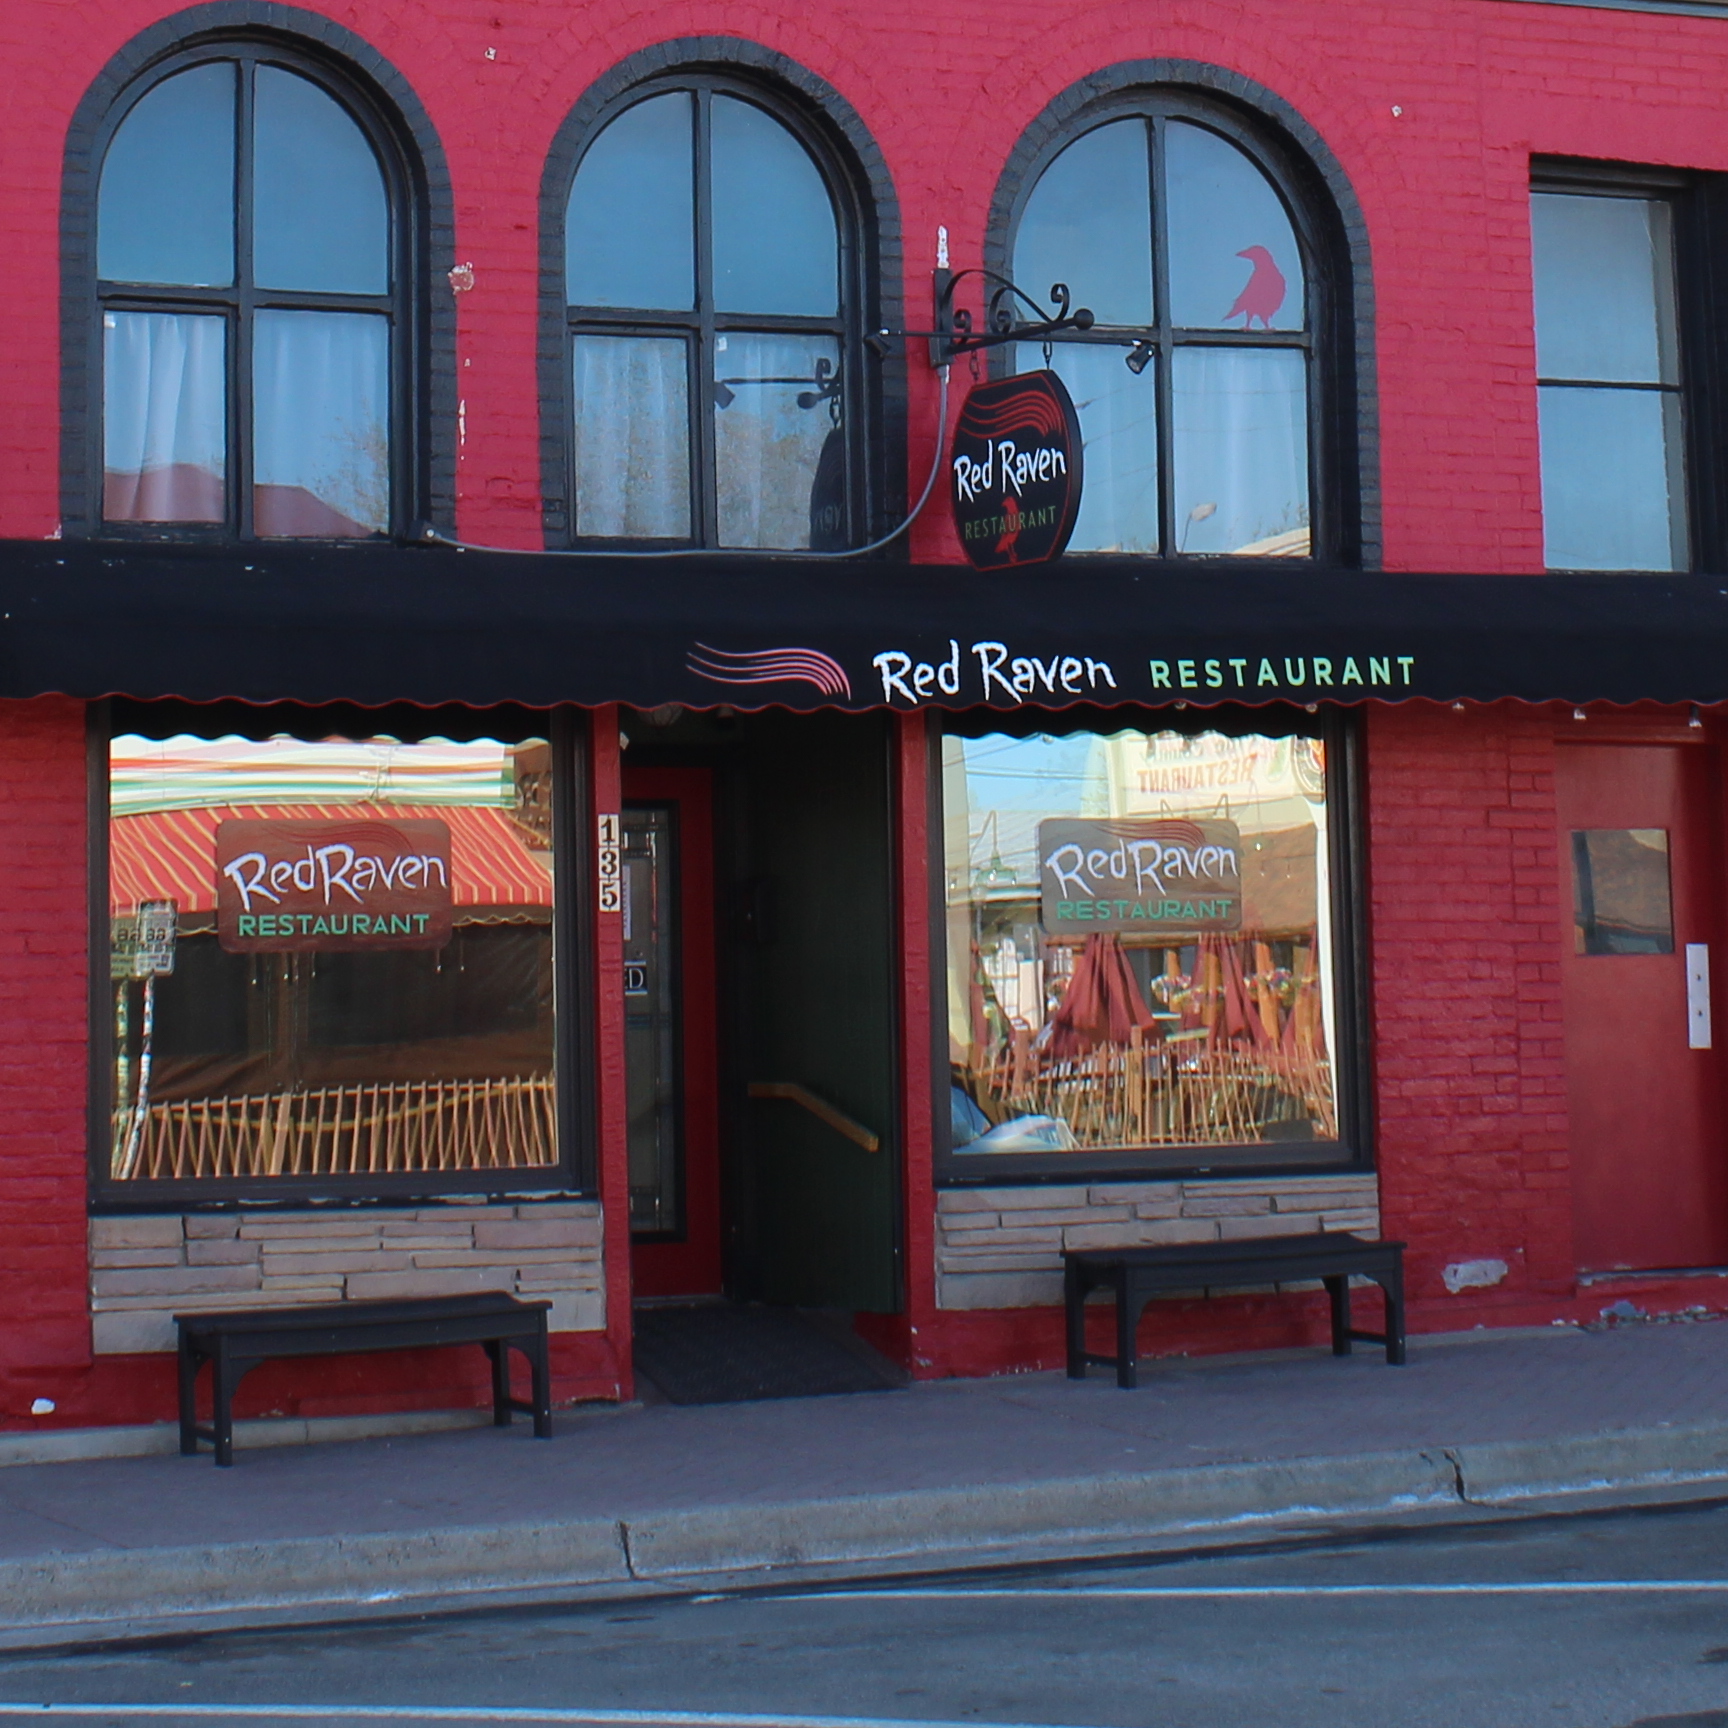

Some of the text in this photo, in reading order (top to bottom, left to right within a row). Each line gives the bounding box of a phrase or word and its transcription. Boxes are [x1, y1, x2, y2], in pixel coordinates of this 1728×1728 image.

[953, 439, 1067, 503] Red Raven
[964, 505, 1057, 540] RESTAURANT
[873, 638, 1415, 704] Red Raven RESTAURANT
[223, 843, 448, 912] Red Raven
[600, 817, 619, 909] 135
[1044, 838, 1239, 900] Red Raven
[238, 913, 430, 937] RESTAURANT
[1056, 899, 1233, 921] RESTAURANT
